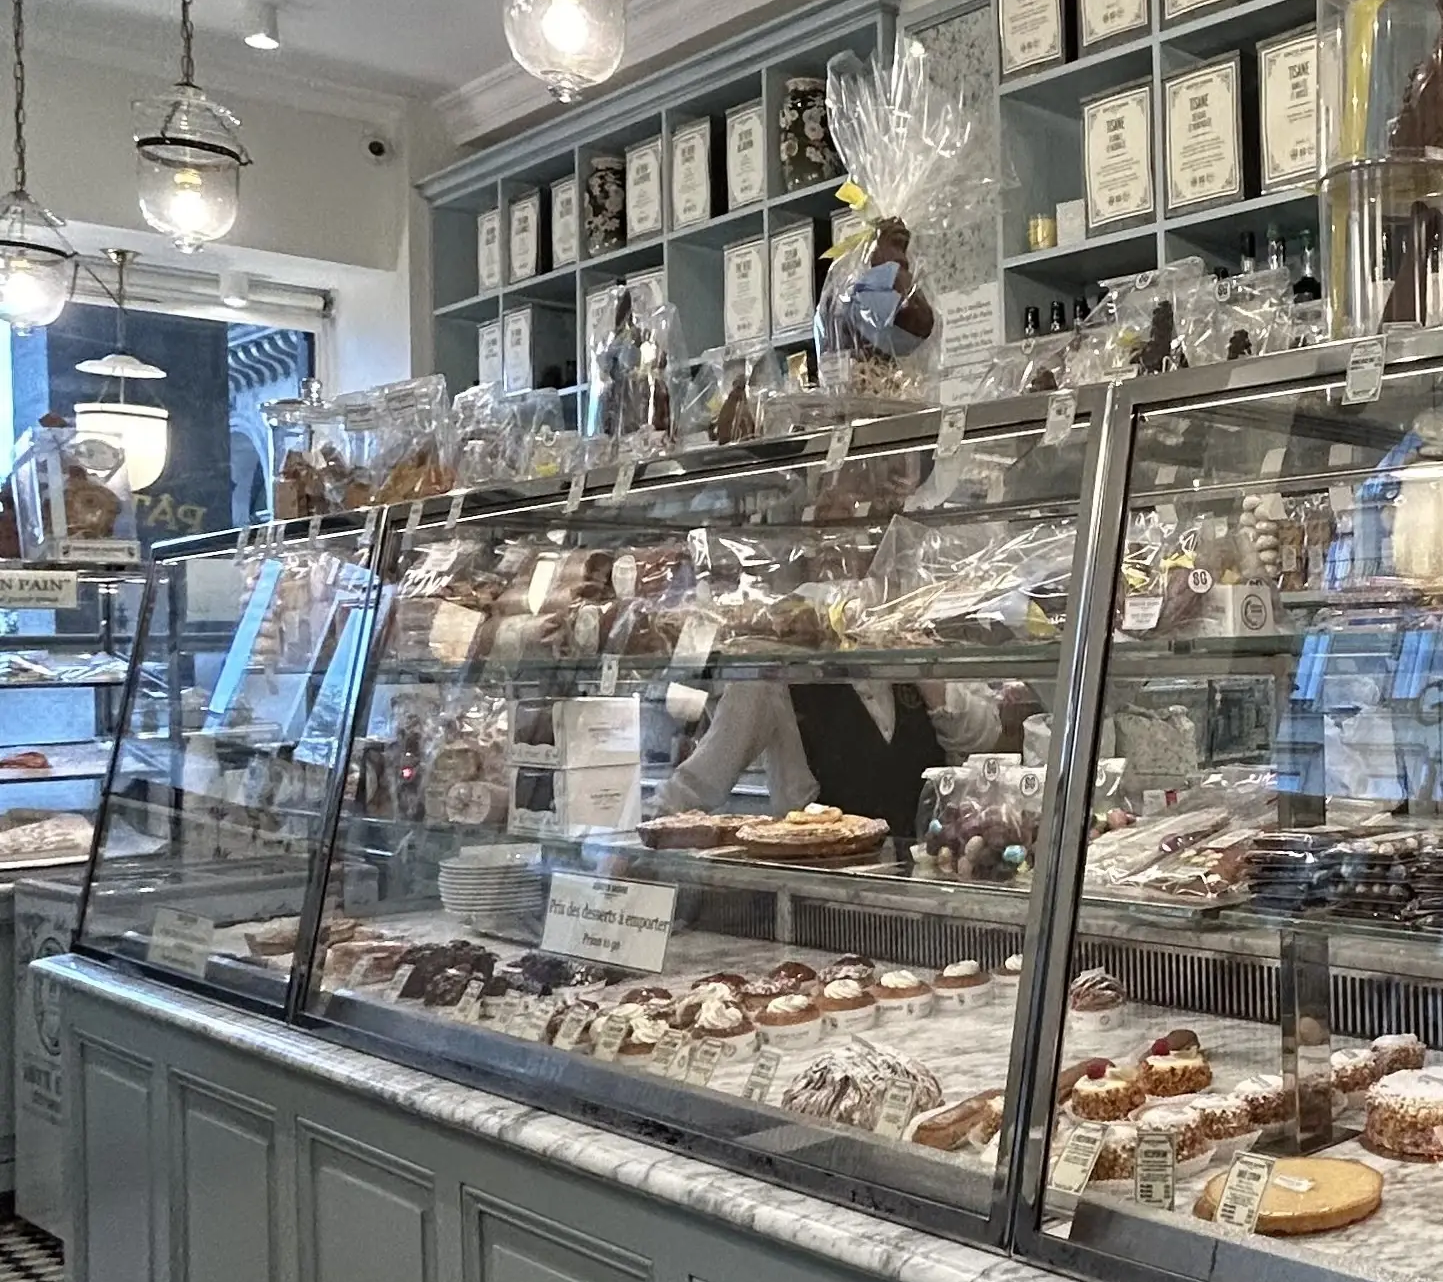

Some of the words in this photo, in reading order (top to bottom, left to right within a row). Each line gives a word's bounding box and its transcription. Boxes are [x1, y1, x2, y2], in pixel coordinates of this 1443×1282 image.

[567, 901, 580, 917] des
[582, 903, 617, 924] desserts
[625, 915, 670, 932] emporter
